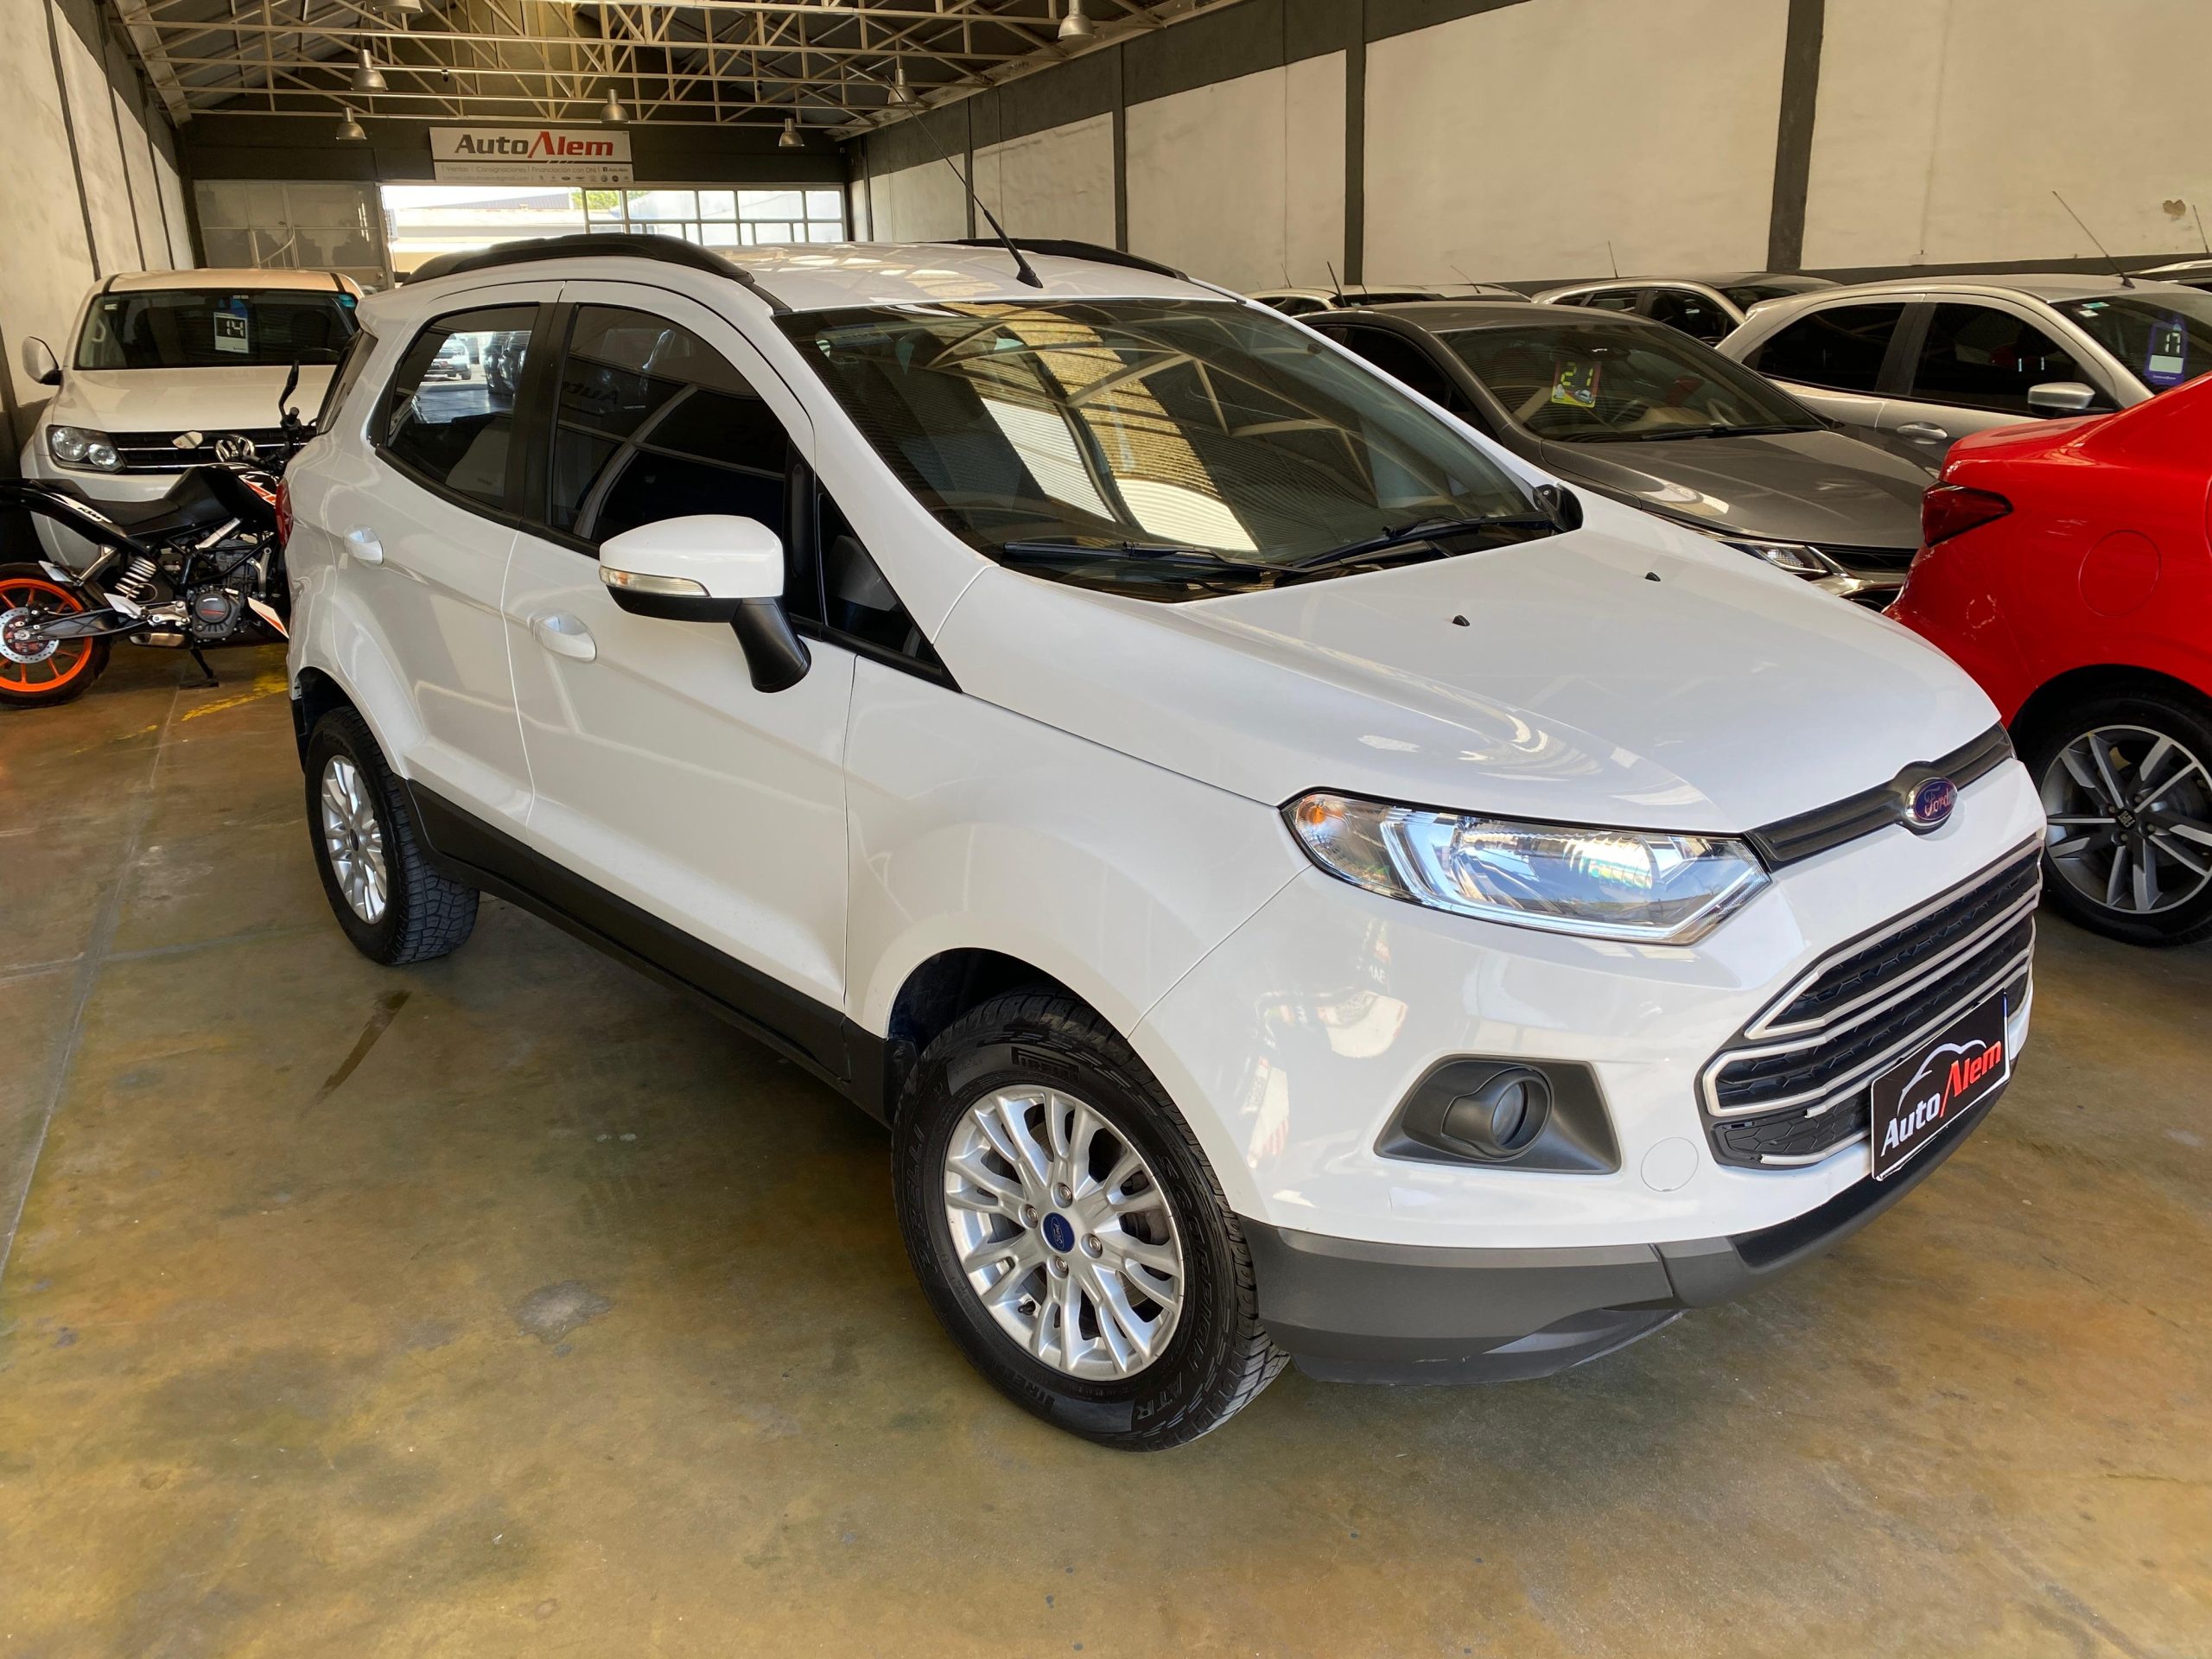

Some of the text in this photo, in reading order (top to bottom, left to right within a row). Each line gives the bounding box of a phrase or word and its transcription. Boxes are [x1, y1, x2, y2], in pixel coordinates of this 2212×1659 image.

[226, 320, 244, 337] 14
[2164, 332, 2181, 353] 17
[1560, 362, 1594, 386] 21
[1923, 785, 1951, 817] Ford
